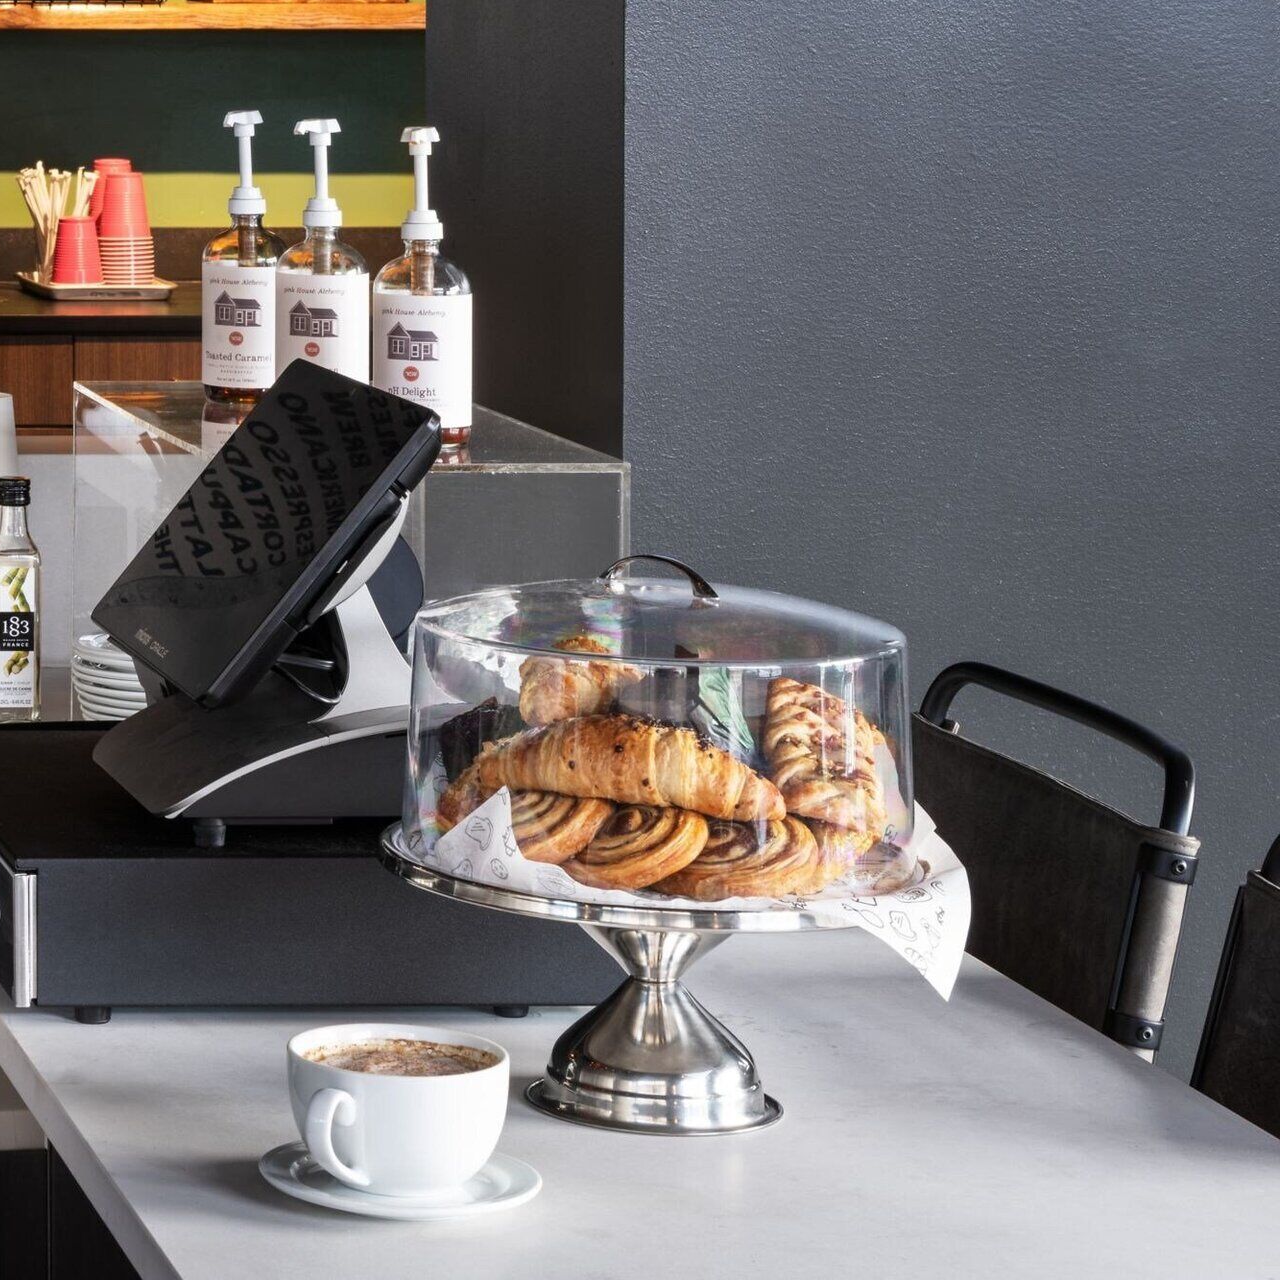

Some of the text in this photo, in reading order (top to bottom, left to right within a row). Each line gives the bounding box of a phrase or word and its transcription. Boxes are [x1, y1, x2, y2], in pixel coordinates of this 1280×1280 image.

[205, 350, 272, 362] Toasted Caramel
[402, 387, 436, 398] Delight
[2, 616, 30, 637] 1883
